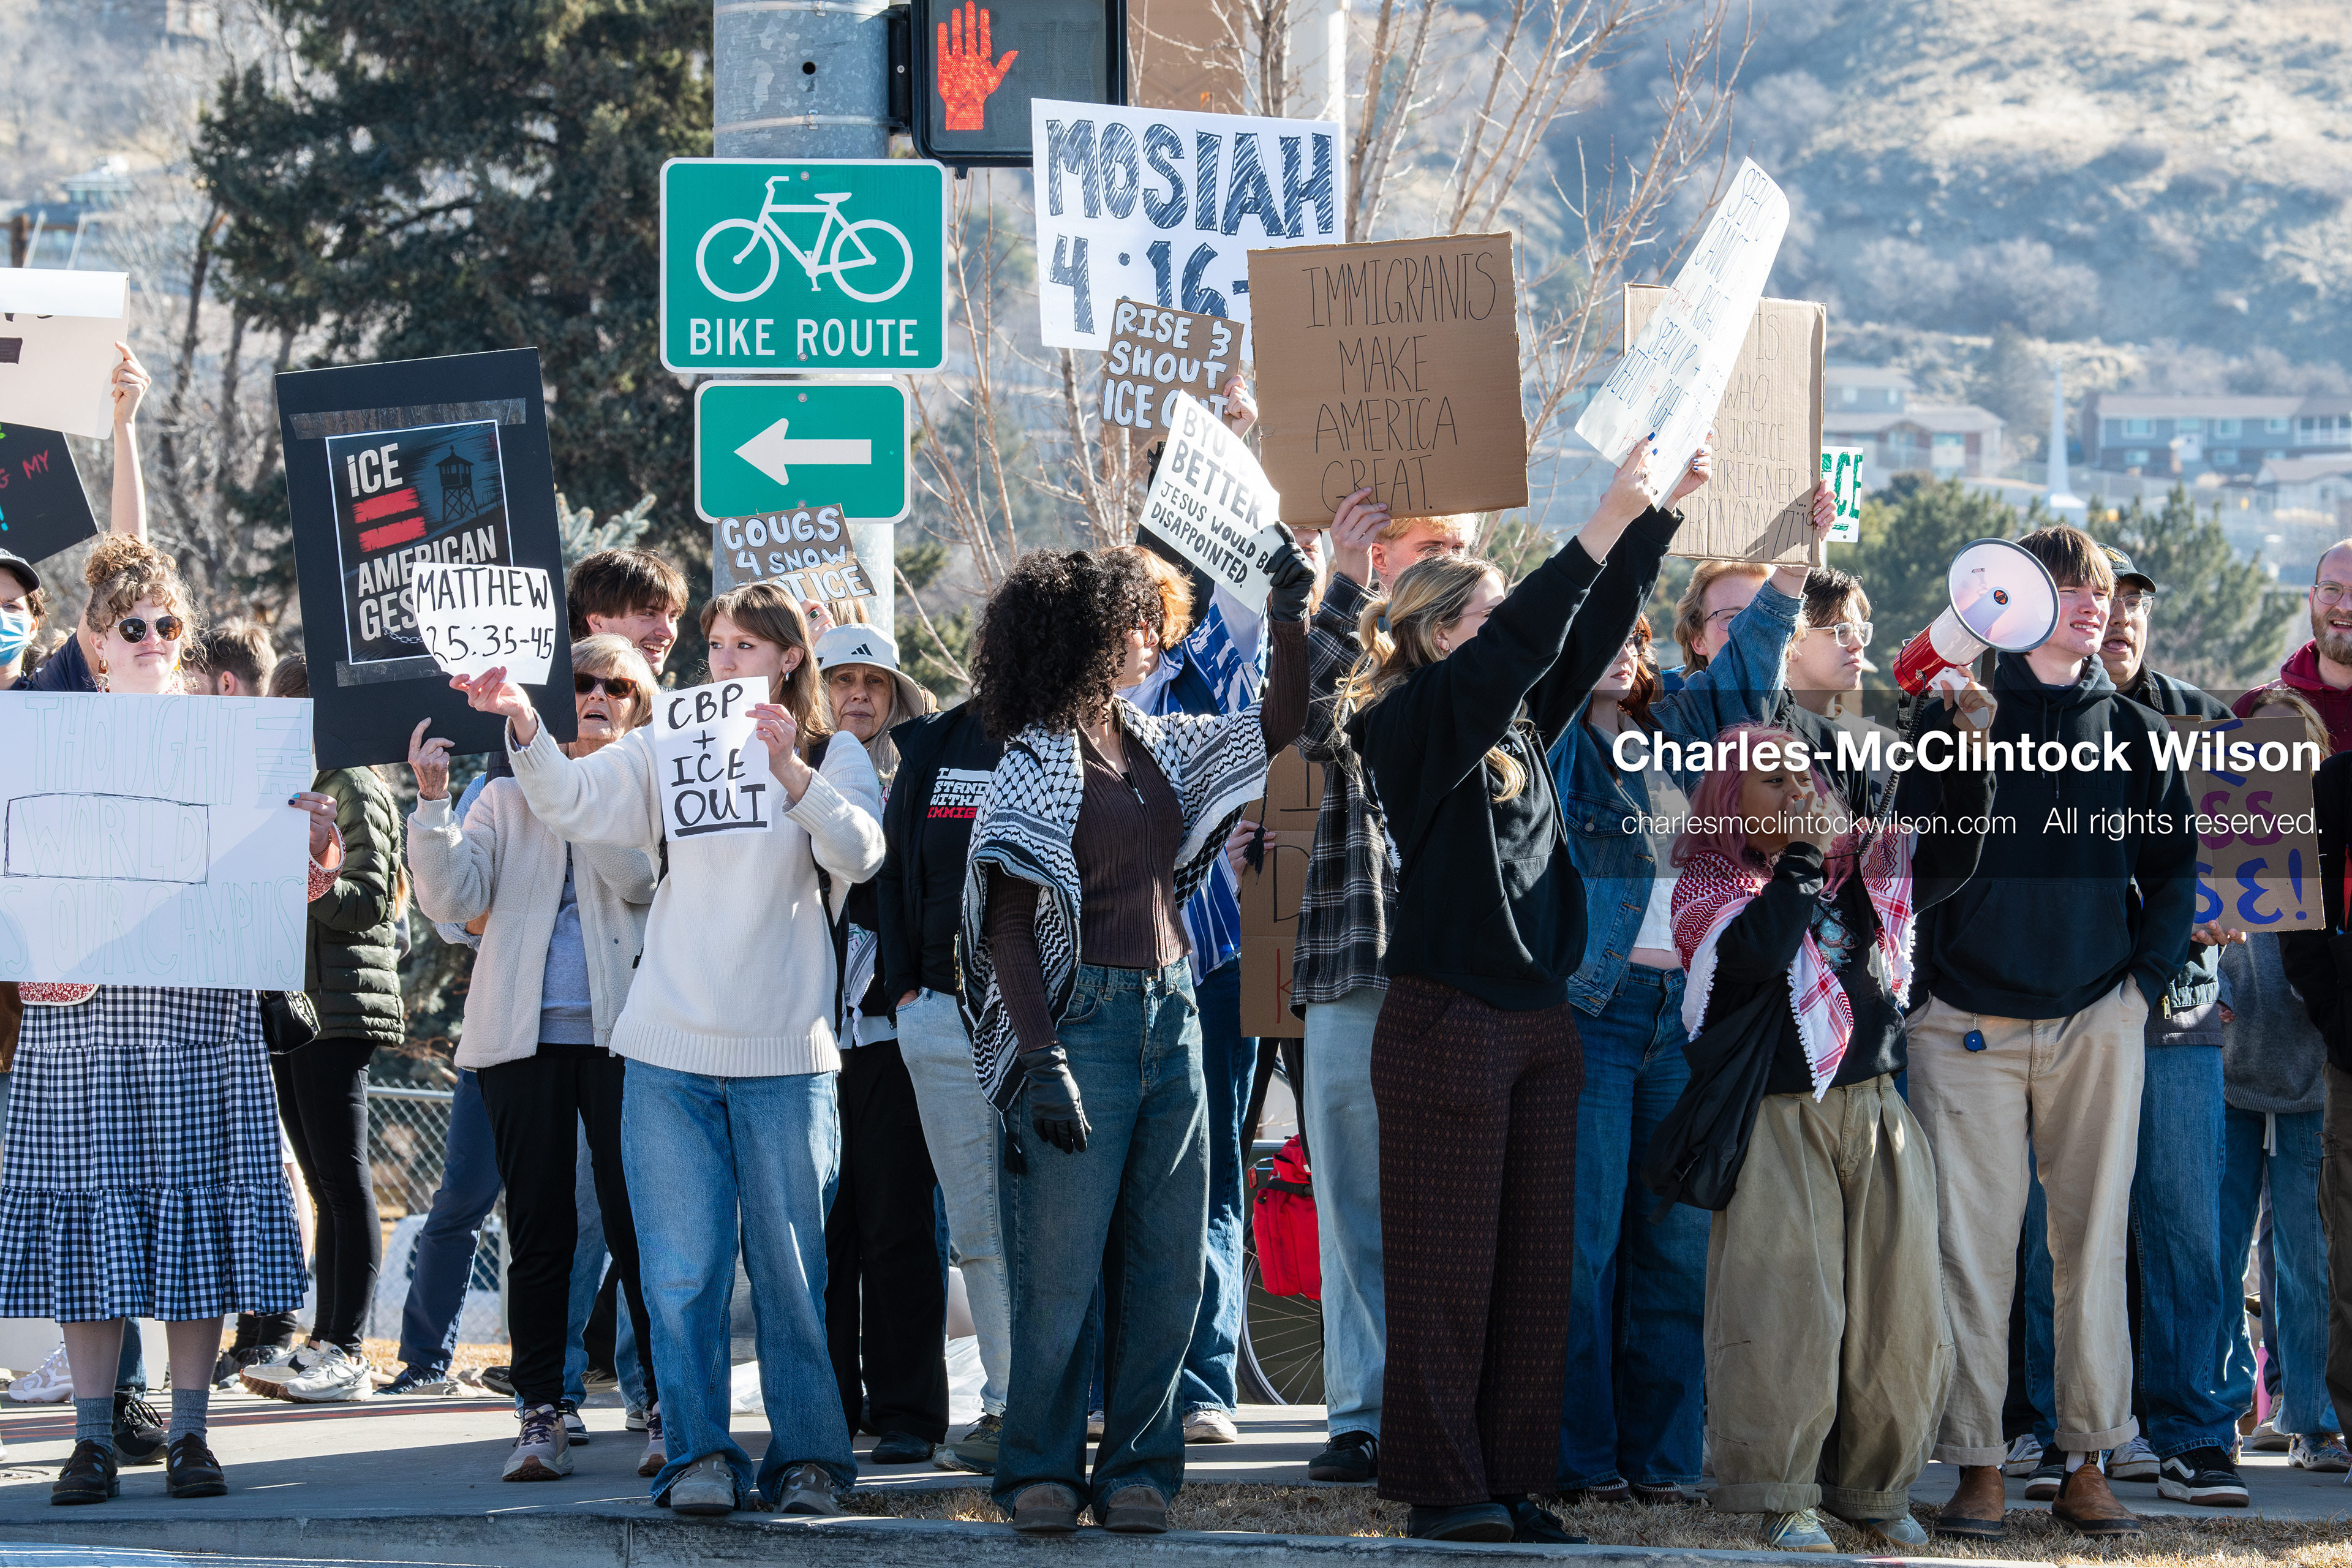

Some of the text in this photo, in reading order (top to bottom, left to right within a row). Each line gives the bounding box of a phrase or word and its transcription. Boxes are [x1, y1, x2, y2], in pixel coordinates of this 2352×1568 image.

[1046, 119, 1333, 239] MOSIAH
[1727, 168, 1776, 235] SPEAK
[1695, 217, 1749, 287] CANNOT
[1302, 252, 1496, 328] IMMIGRANTS
[1667, 268, 1690, 306] for
[1677, 283, 1697, 317] the
[690, 318, 919, 356] BIKE ROUTE
[1115, 301, 1193, 350] RISE
[1648, 317, 1687, 369] SPEAK
[1670, 339, 1698, 376] UP
[1755, 314, 1780, 361] IS
[1109, 340, 1228, 390] SHOUT
[1339, 335, 1428, 394] MAKE
[1606, 344, 1656, 410] DEFEND
[1646, 379, 1658, 398] the
[1103, 378, 1229, 430] ICE OT
[1724, 372, 1770, 412] WHO
[1316, 396, 1457, 453] AMERICA
[1727, 418, 1785, 462] JUSTICE
[22, 449, 49, 480] MY
[721, 506, 842, 551] COUGS
[1160, 481, 1207, 522] JESUS
[1211, 515, 1256, 559] WOULD
[736, 544, 847, 576] 4 SNOW
[1150, 501, 1248, 589] DISAPPOINTED.
[417, 567, 548, 614] MATTHEW
[808, 565, 872, 603] ICE
[426, 625, 554, 664] 25:35-45
[668, 684, 743, 730] CBP
[25, 695, 312, 806] THOUGHT THE
[692, 729, 717, 750] +
[671, 748, 746, 787] ICE
[674, 783, 767, 827] OUT
[20, 796, 204, 884] WORLD
[0, 875, 305, 989] S OUR CAMPUS
